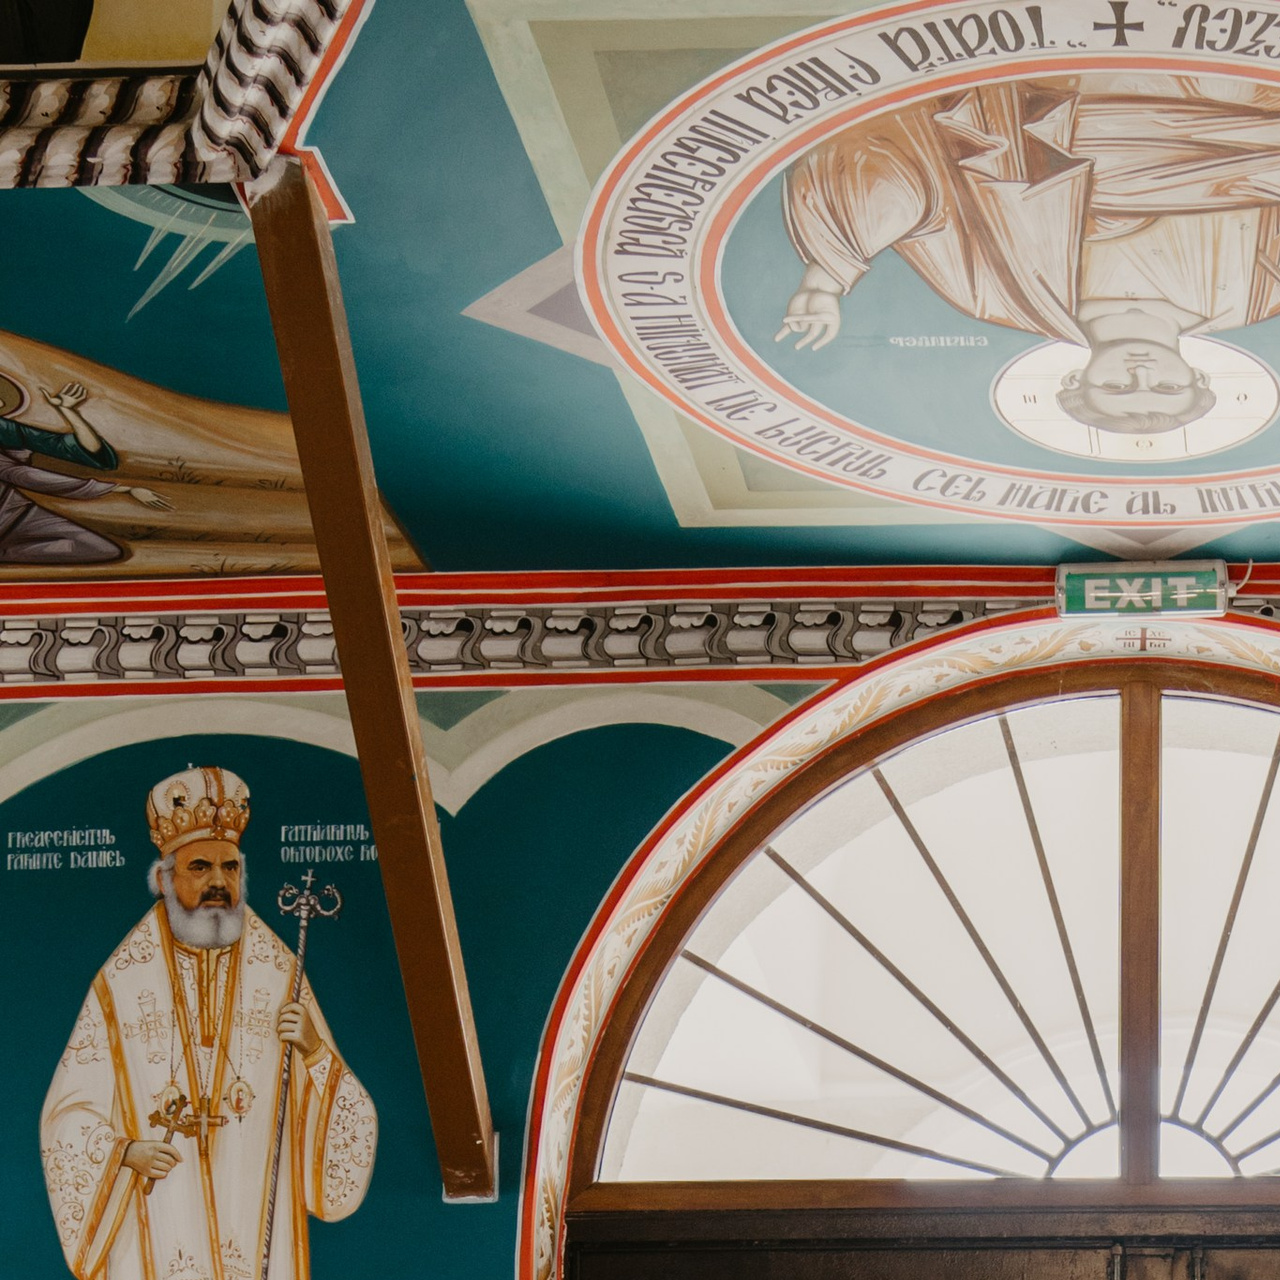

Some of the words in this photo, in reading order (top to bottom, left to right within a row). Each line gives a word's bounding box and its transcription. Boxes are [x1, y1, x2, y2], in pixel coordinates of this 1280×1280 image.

[913, 469, 986, 503] CEL
[1126, 485, 1176, 516] AL
[1084, 577, 1196, 609] EXIT
